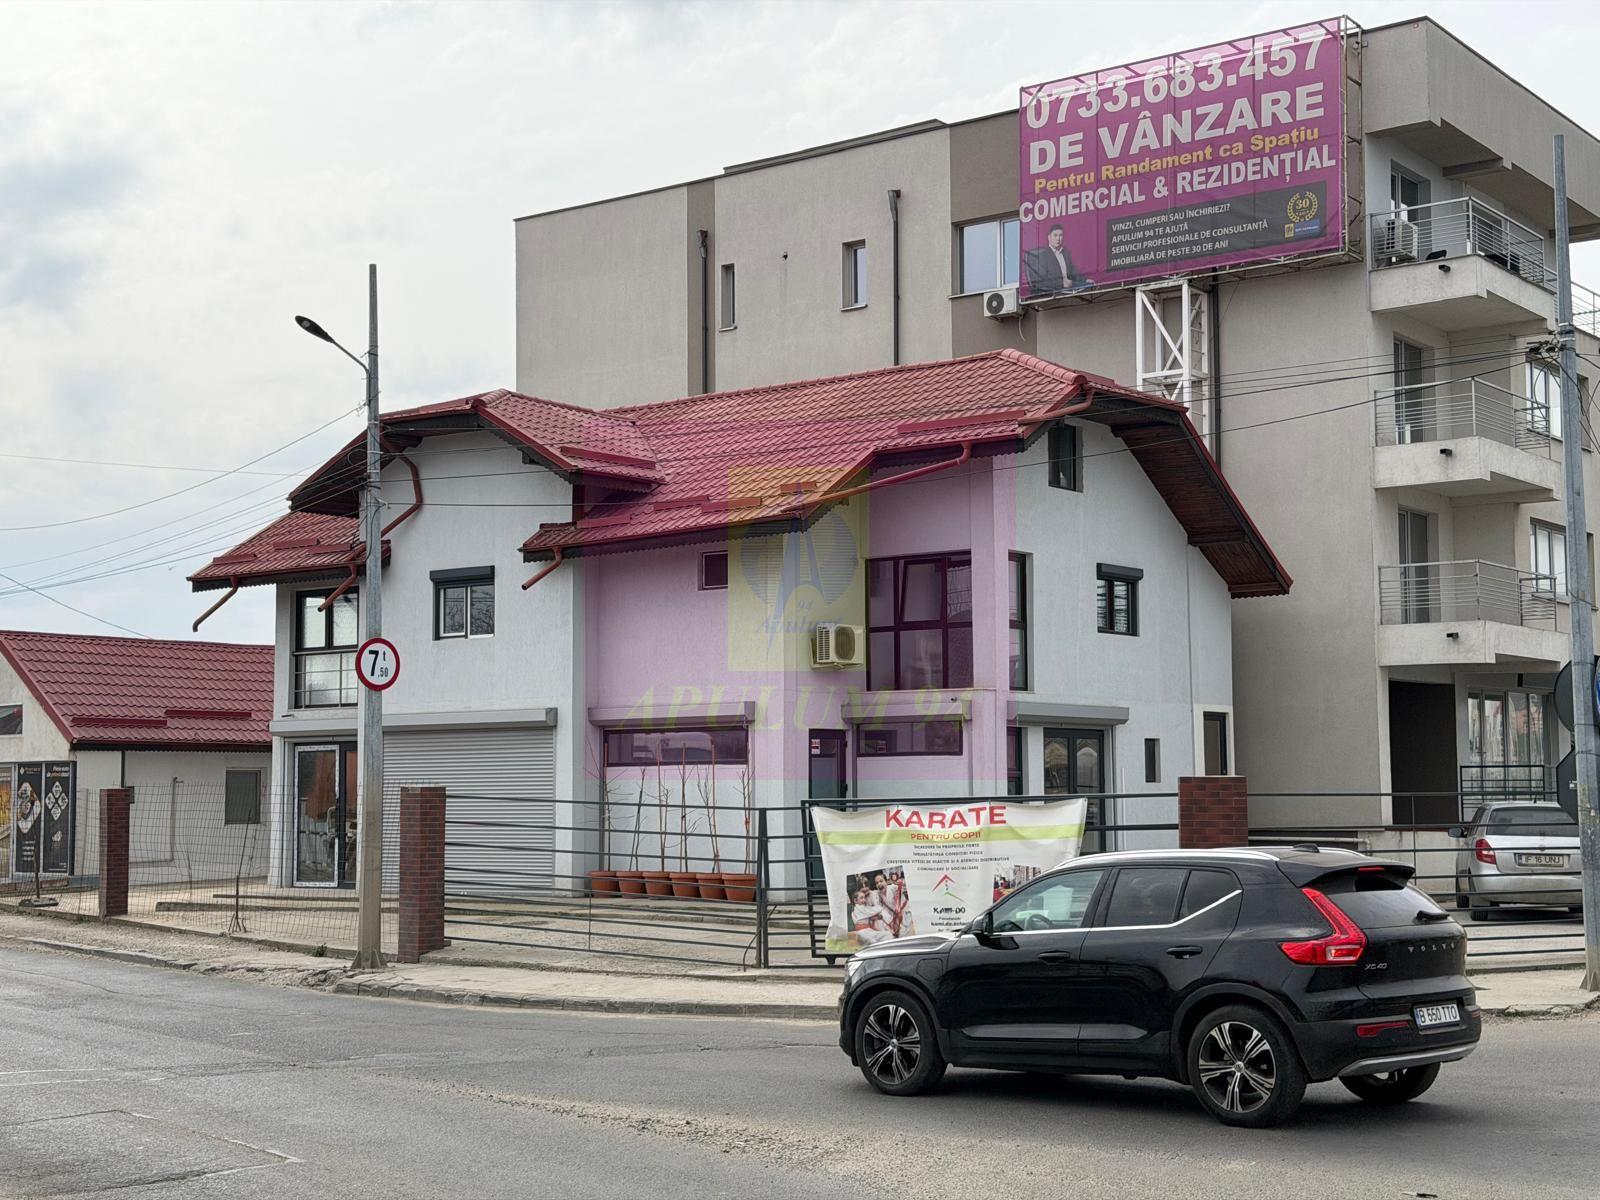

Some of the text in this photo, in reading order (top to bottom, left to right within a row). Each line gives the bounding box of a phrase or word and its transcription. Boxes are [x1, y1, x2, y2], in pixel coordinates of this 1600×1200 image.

[1026, 30, 1326, 128] 0733.683.457
[1029, 82, 1324, 174] DE VÂNZARE
[1034, 126, 1319, 194] Pentru Randament ca Spațiu
[1019, 144, 1336, 223] COMERCIAL & REZIDENȚIAL
[1295, 198, 1310, 209] 30
[1112, 203, 1231, 232] VINZI, CUMPERI SAU ÎNCHIRIEZI?
[1111, 243, 1142, 254] SERVICII
[1143, 232, 1199, 248] PROFESIONALE
[1200, 230, 1211, 238] DE
[1112, 222, 1189, 243] APULUM 94 TE AJUTĂ
[1111, 240, 1229, 267] IMOBILIARĂ DE PESTE 30 DE ANI
[368, 649, 379, 677] 7
[885, 805, 1007, 829] KARATE
[910, 831, 981, 841] PENTRU COPII
[1535, 855, 1542, 864] 16
[1407, 942, 1456, 953] VOLVO
[1419, 1009, 1427, 1024] B
[1441, 1005, 1458, 1021] TTO
